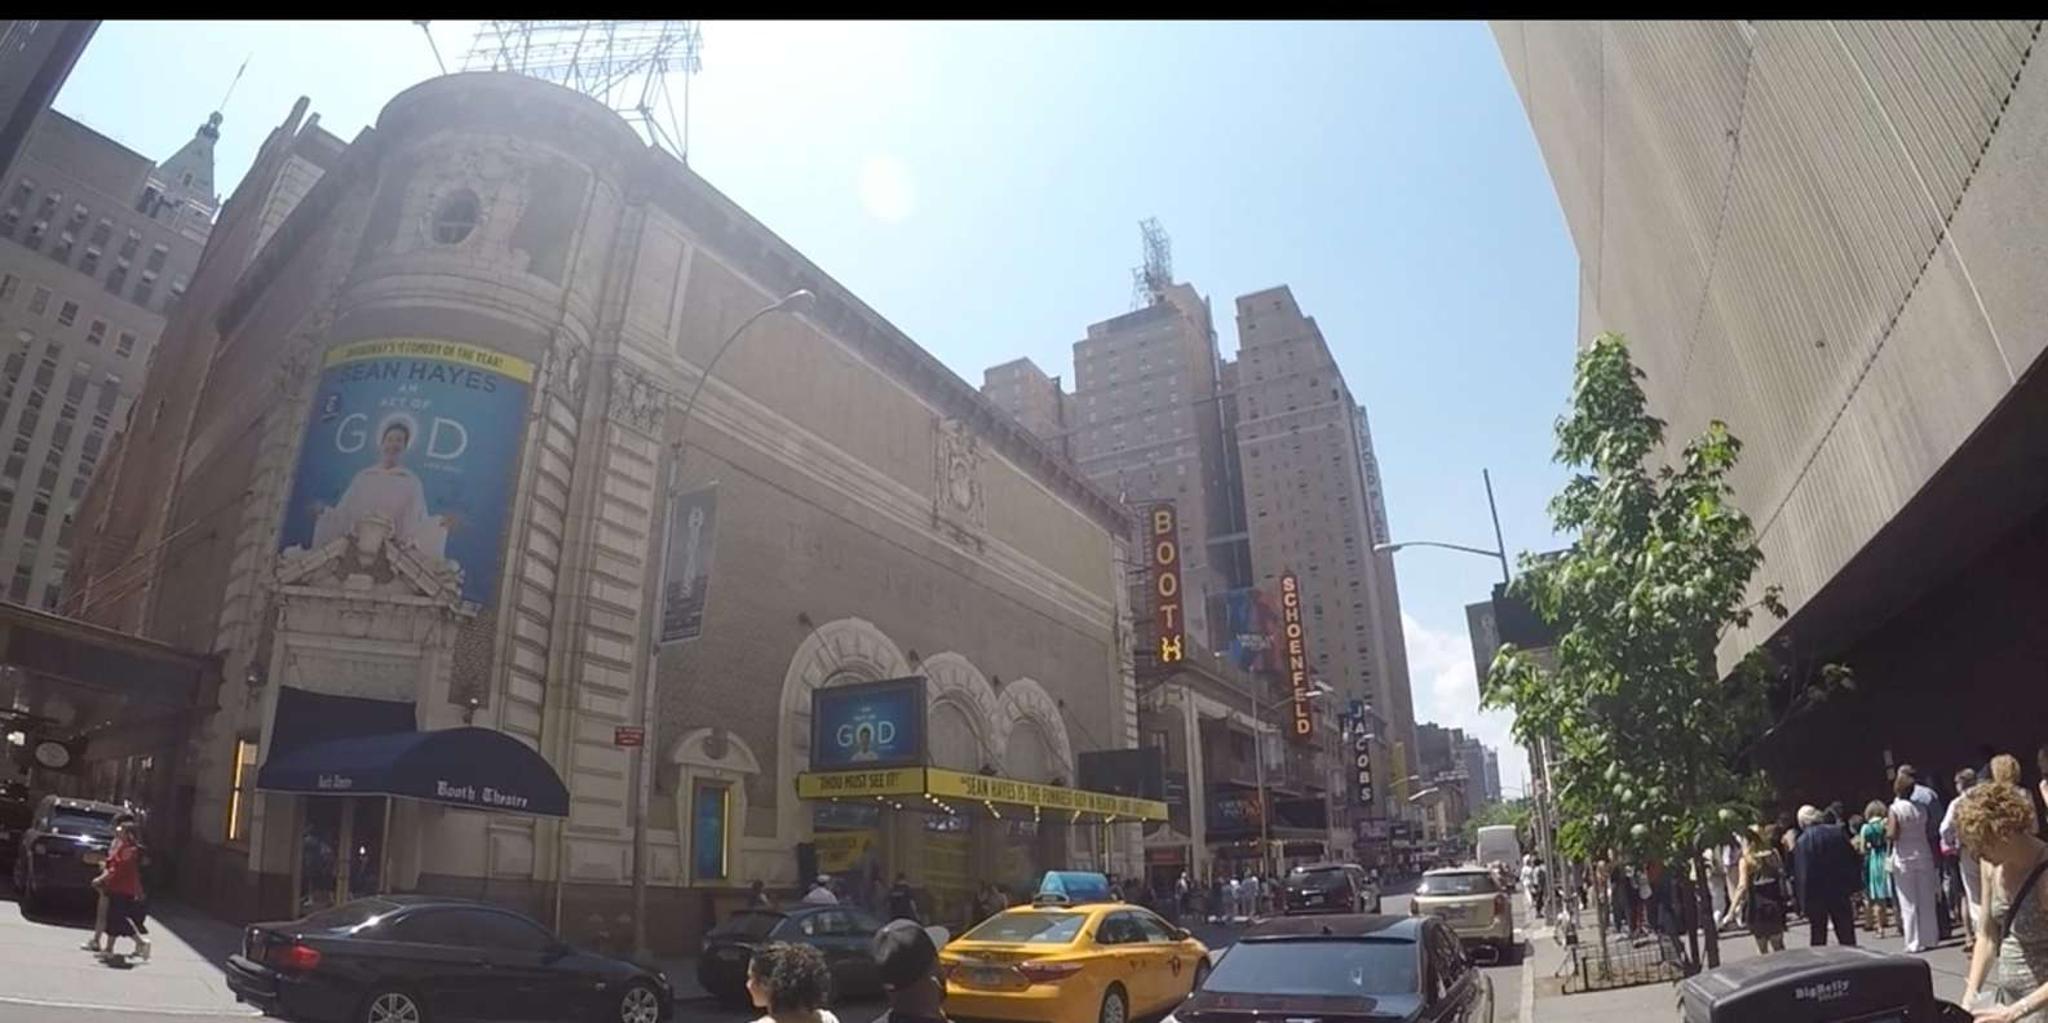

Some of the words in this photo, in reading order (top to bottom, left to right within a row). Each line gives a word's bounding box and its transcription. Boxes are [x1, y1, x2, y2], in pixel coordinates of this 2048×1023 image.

[339, 361, 400, 385] SEAN
[408, 361, 497, 394] HAYES
[335, 412, 468, 460] GOD
[1153, 510, 1183, 663] BOOTH
[1281, 575, 1311, 735] SCHOENFELD
[836, 721, 896, 747] GOD
[1354, 703, 1372, 802] JACOBS
[437, 780, 476, 801] Booth
[482, 787, 529, 808] Theatre
